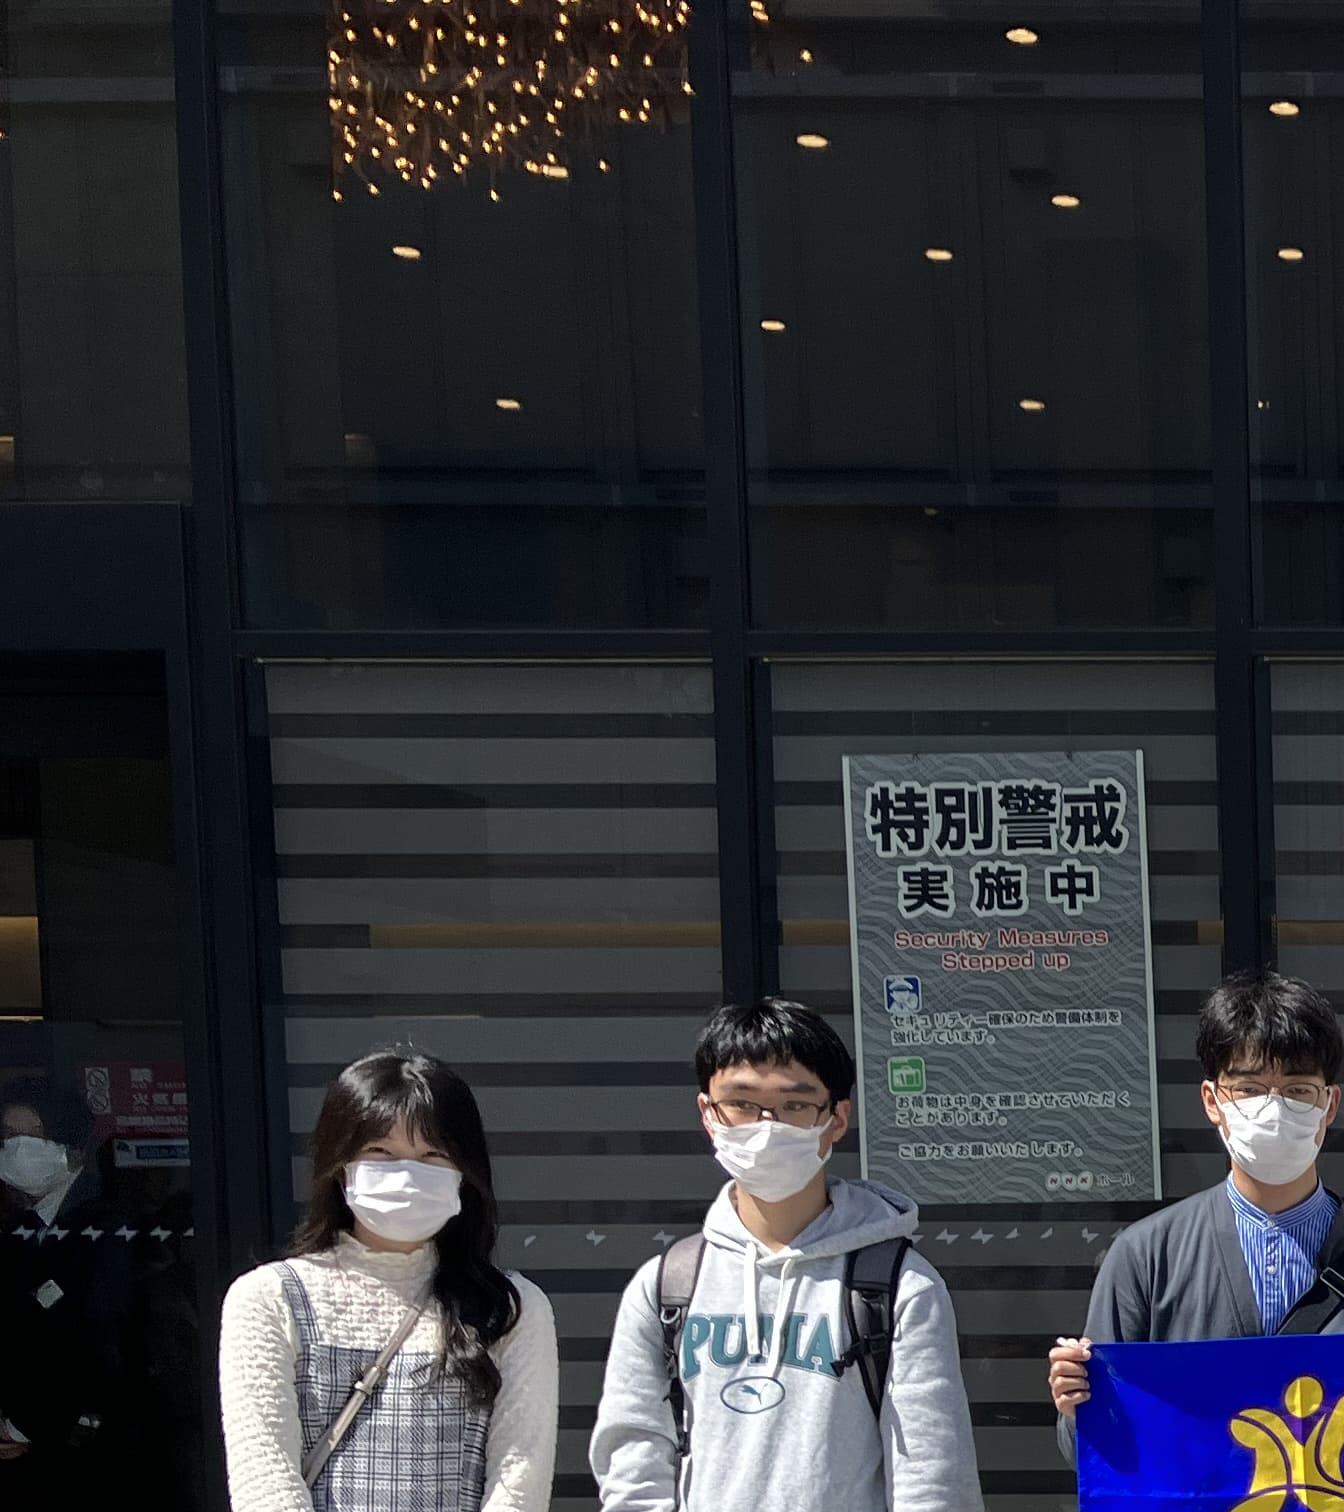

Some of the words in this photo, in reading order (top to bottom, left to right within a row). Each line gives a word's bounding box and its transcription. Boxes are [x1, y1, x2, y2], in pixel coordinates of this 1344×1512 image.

[869, 783, 1124, 852] 特別警戒
[902, 863, 1097, 914] 実施中
[895, 930, 988, 950] Security
[999, 928, 1109, 947] Measures
[942, 951, 1034, 972] Stepped
[1042, 954, 1071, 971] up
[896, 1111, 1008, 1127] ことがあります。
